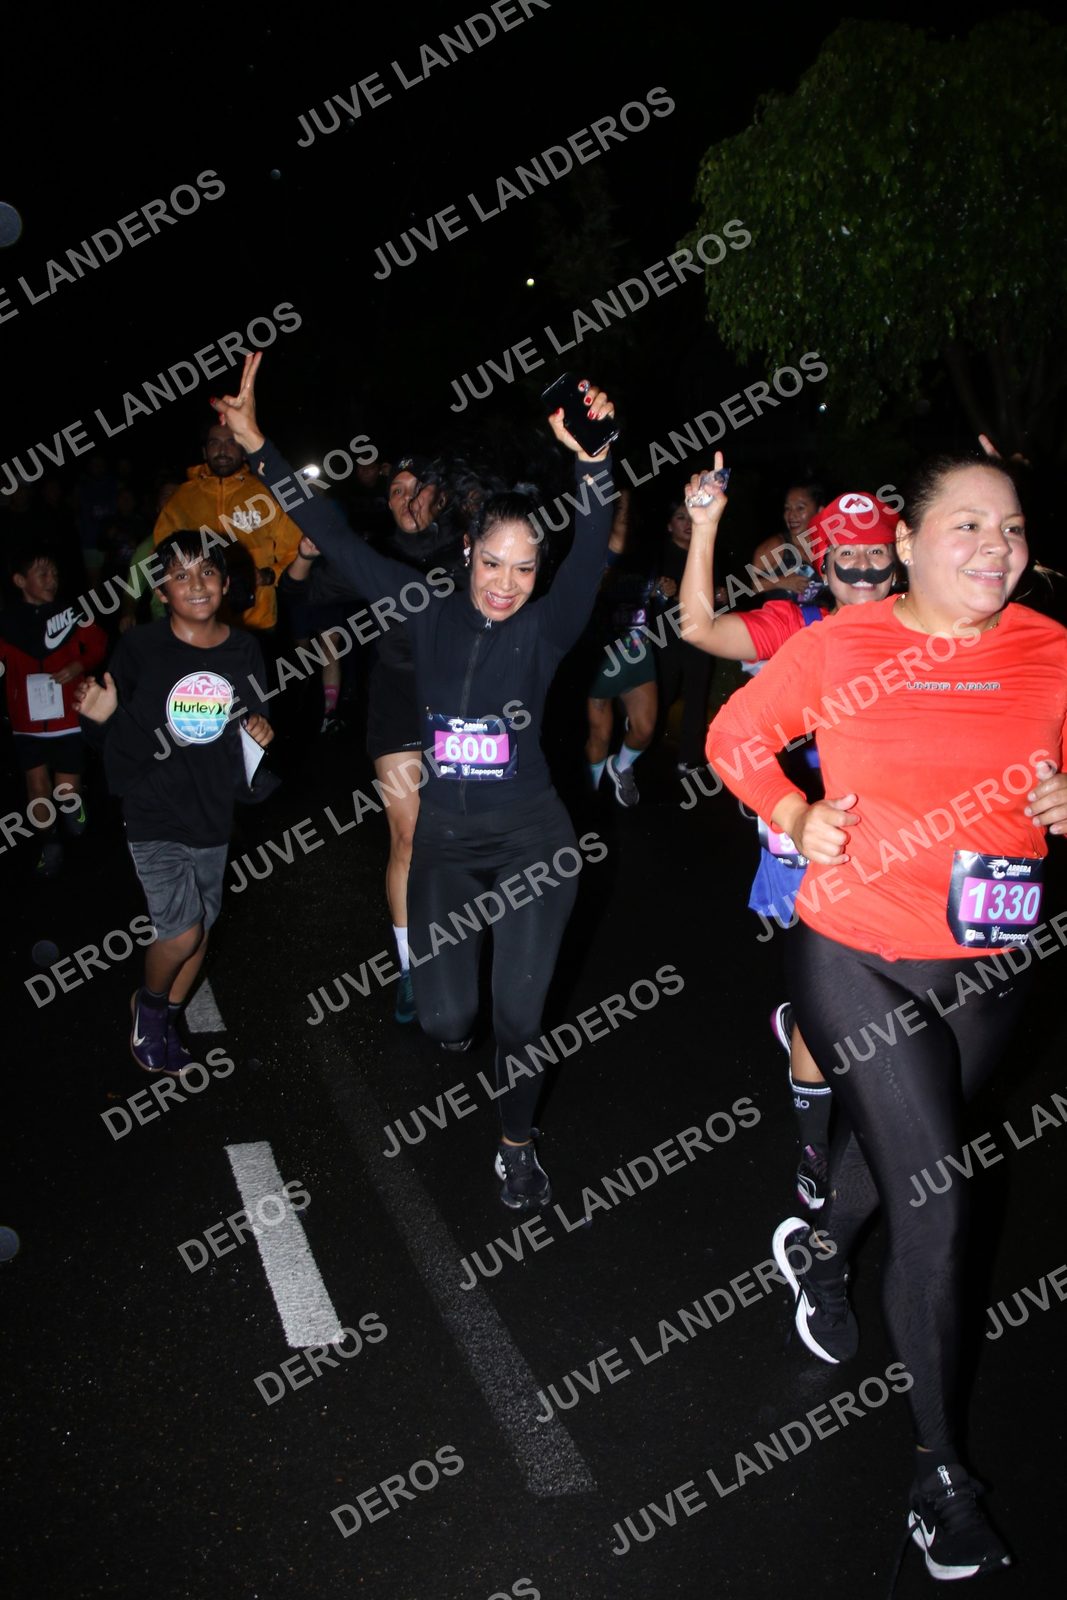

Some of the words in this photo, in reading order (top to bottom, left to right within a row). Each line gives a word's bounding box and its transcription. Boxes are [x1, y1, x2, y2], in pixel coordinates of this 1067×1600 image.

[46, 606, 75, 637] NIKE
[173, 701, 216, 715] Hurley
[445, 735, 498, 762] 600
[968, 882, 1041, 921] 1330
